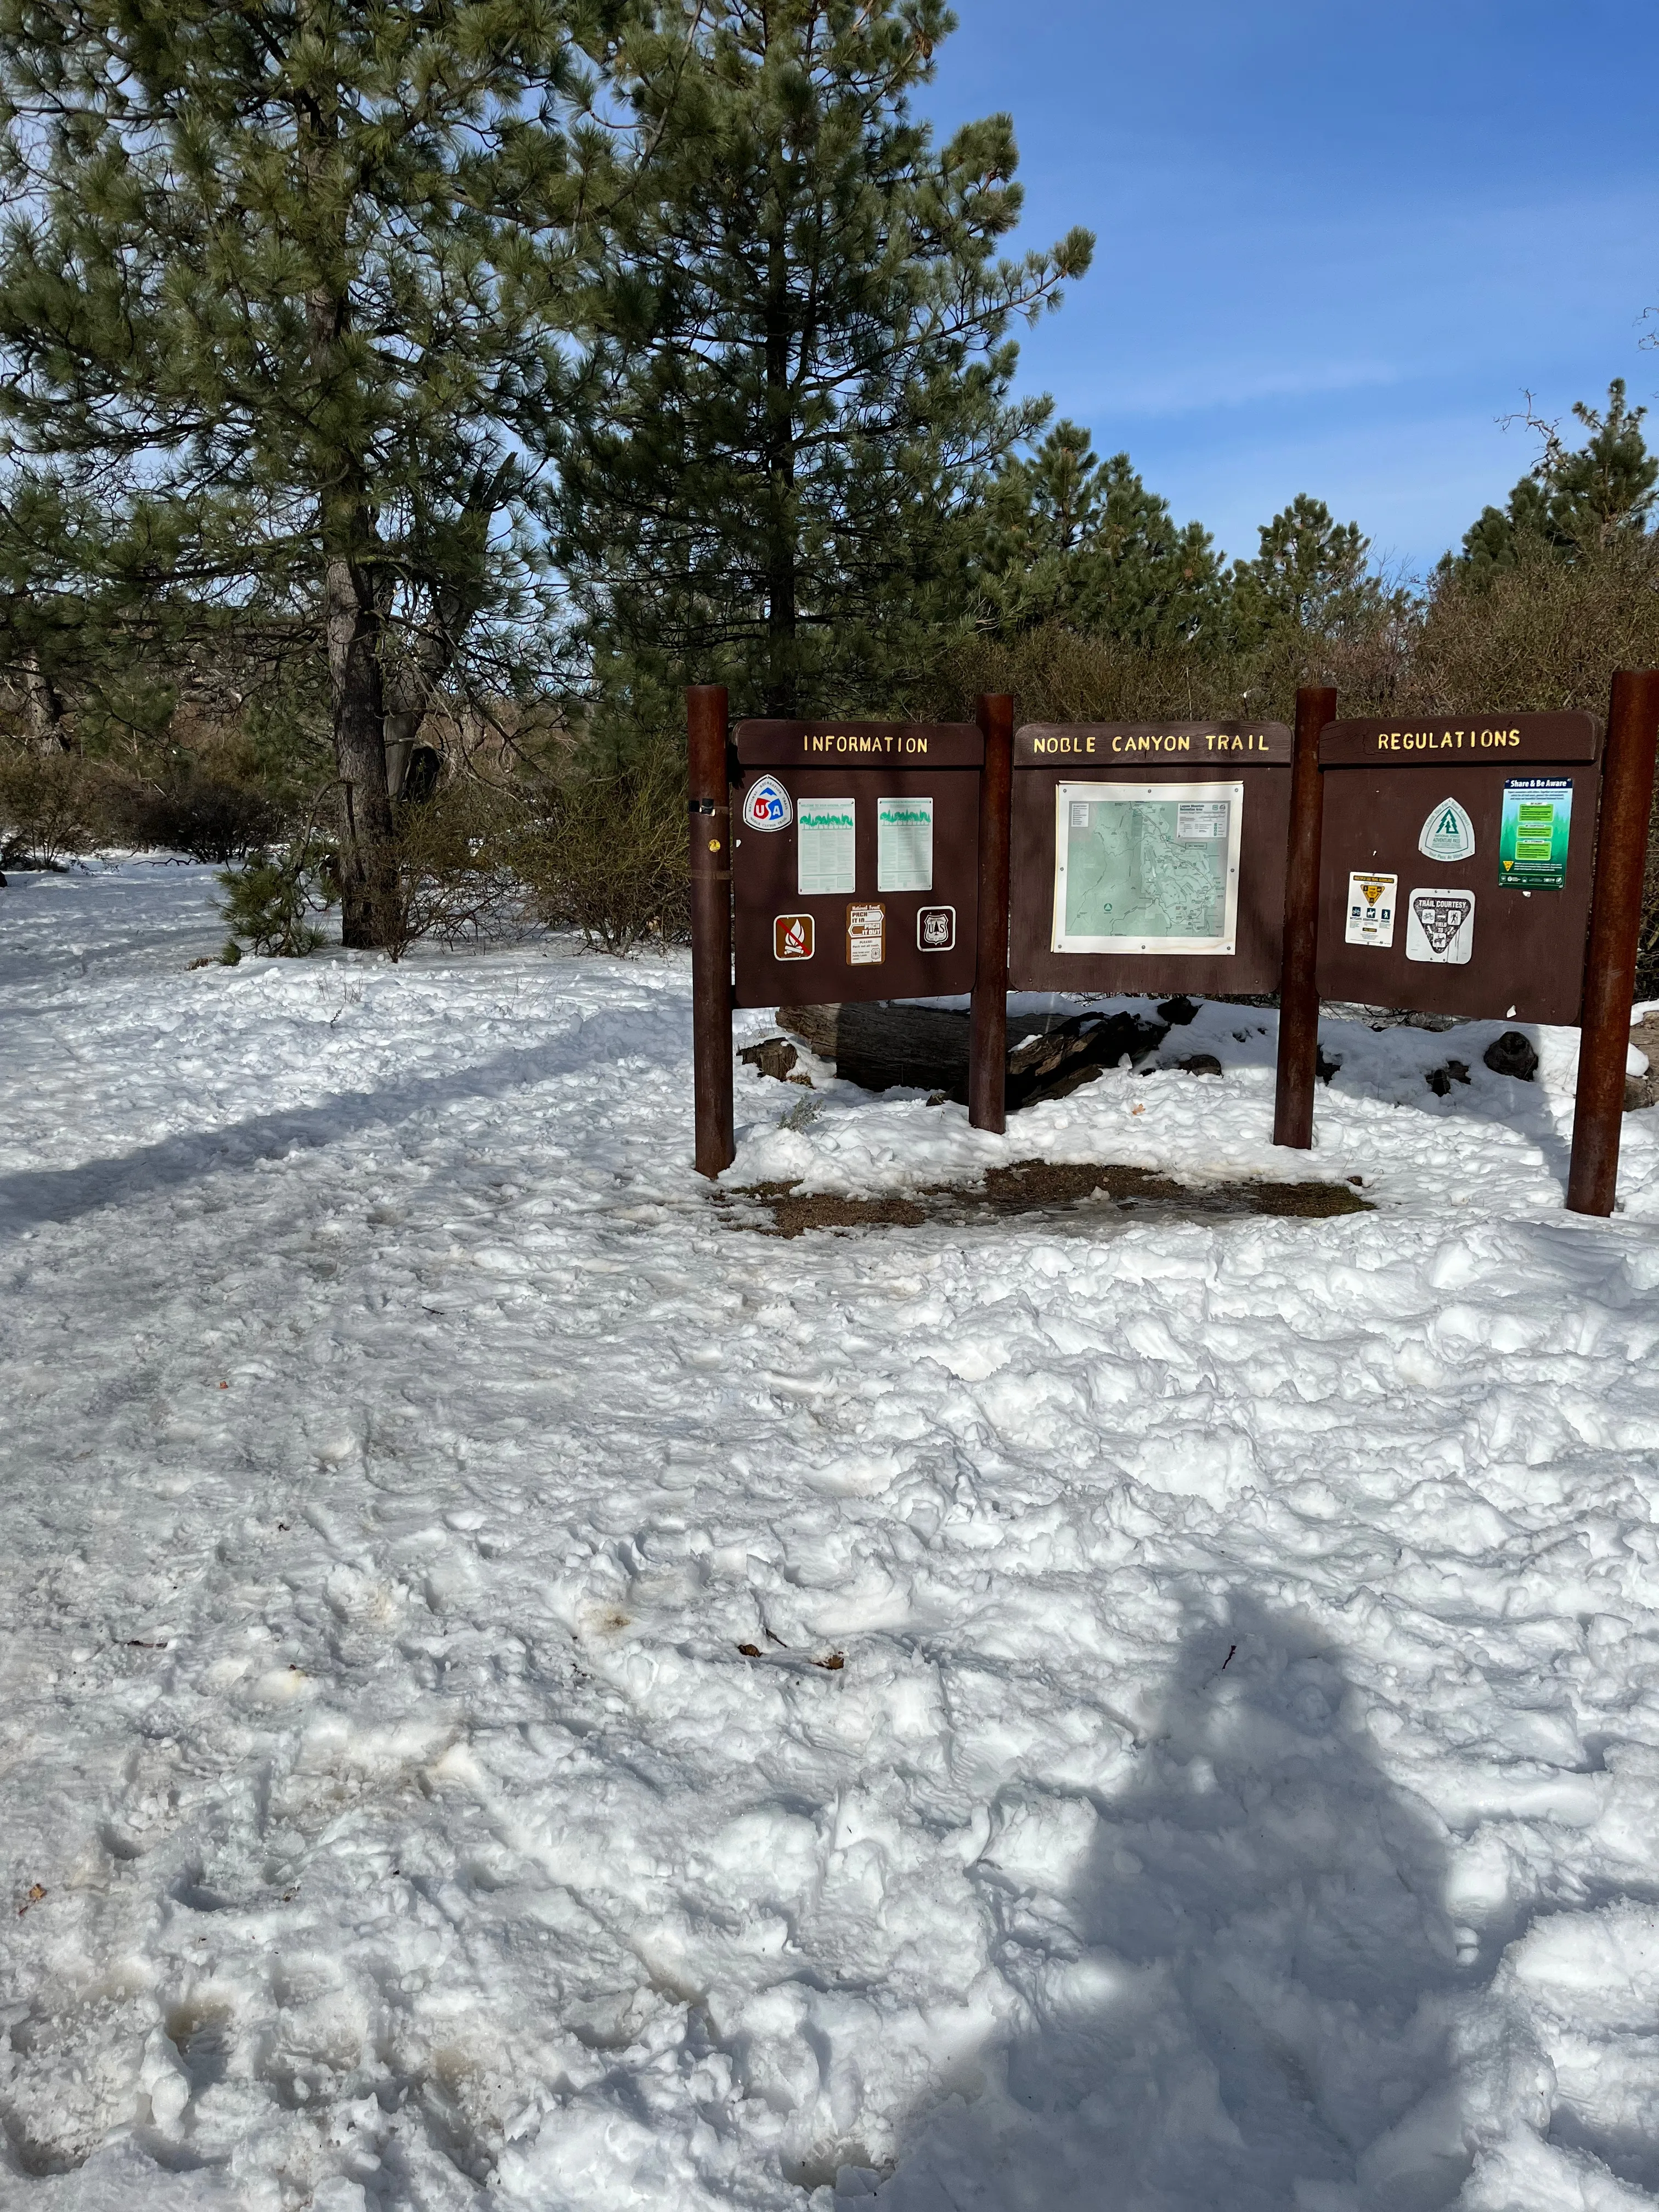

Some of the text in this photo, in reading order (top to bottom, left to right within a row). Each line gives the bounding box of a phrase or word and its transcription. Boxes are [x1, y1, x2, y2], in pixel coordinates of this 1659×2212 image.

[804, 735, 928, 753] INFORMATION
[1034, 735, 1269, 753] NOBLE CANYON TRAIL
[1378, 729, 1520, 750] REGULATIONS
[759, 781, 782, 794] RECREATION
[755, 802, 781, 817] USA
[1459, 809, 1470, 826] Support
[1436, 900, 1466, 909] COURTESY
